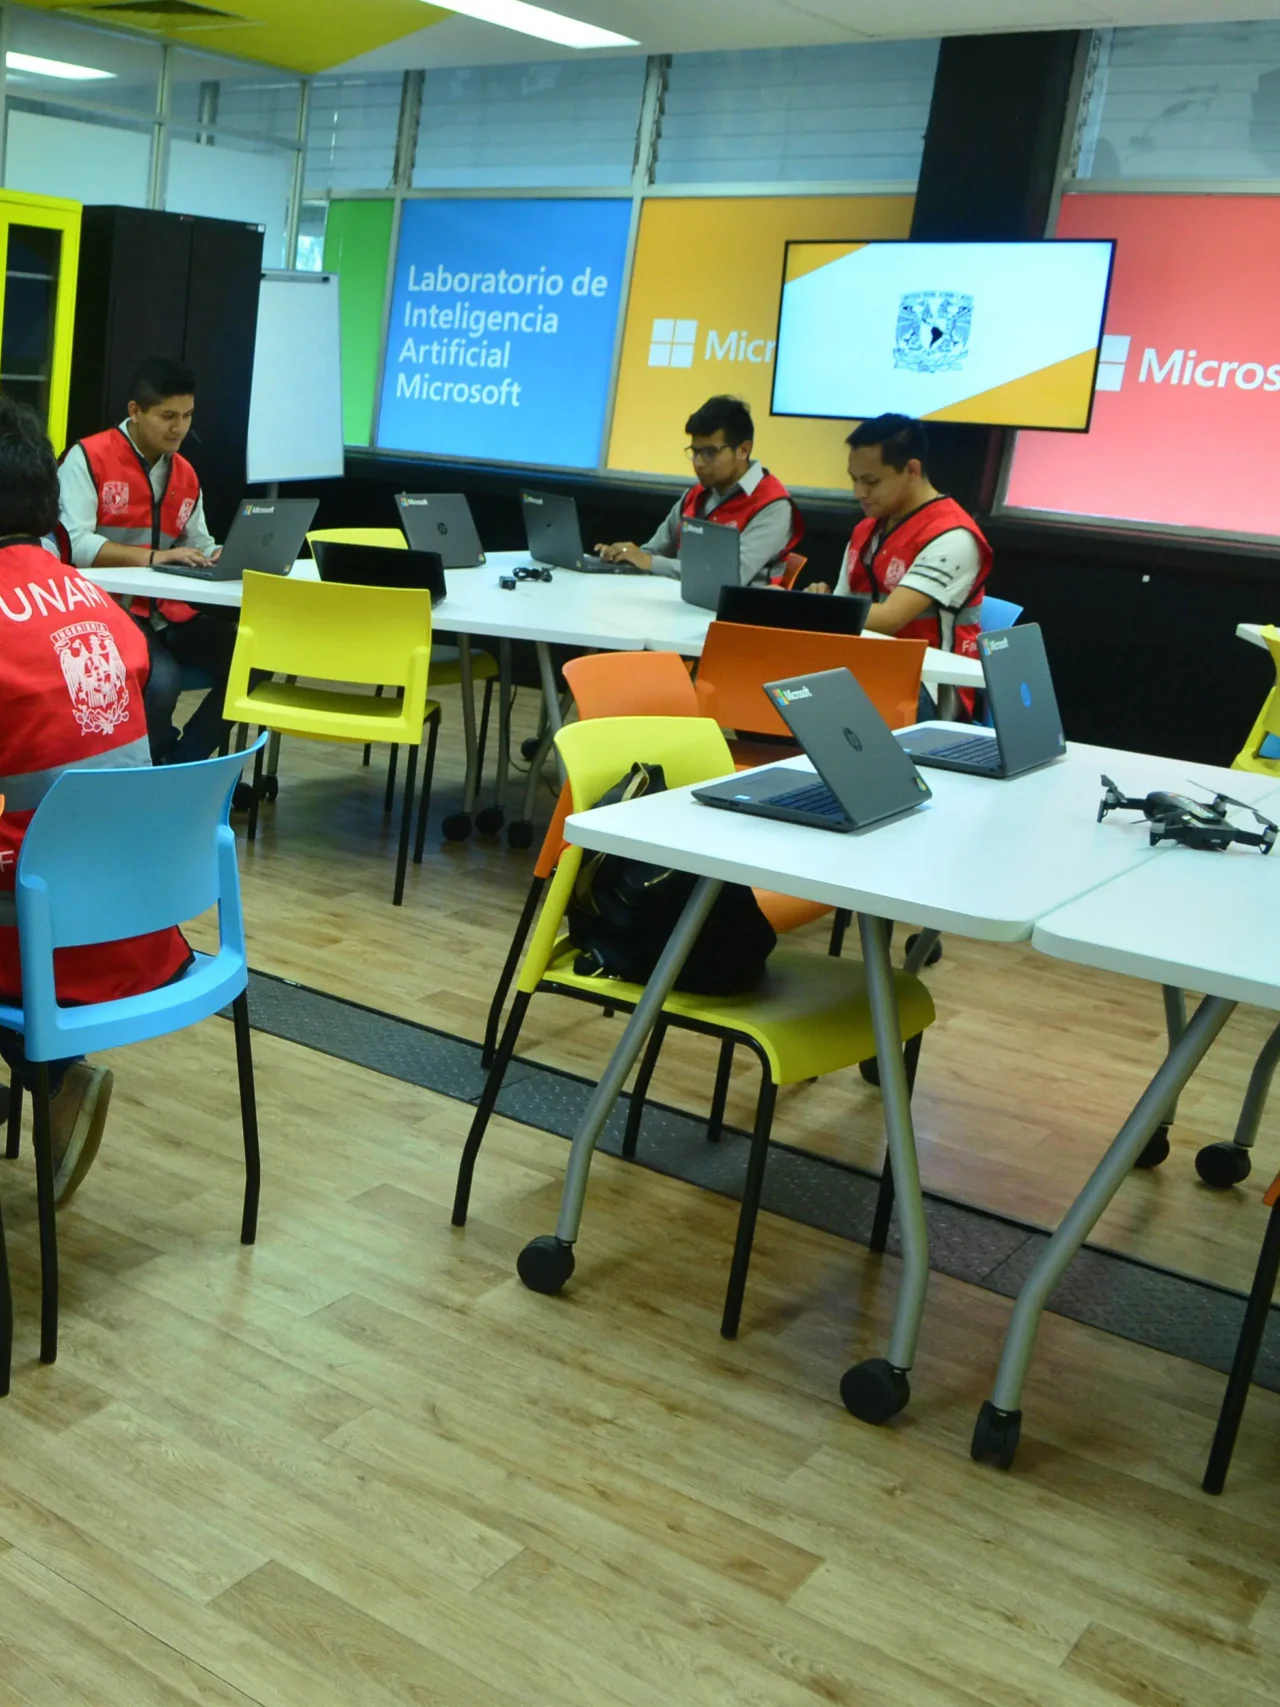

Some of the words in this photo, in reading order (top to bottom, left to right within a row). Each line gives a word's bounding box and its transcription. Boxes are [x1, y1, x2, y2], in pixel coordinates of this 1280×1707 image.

[407, 264, 564, 296] Laboratorio
[571, 266, 608, 297] de
[403, 301, 559, 338] Inteligencia
[398, 336, 511, 368] Artificial
[396, 372, 521, 406] Microsoft
